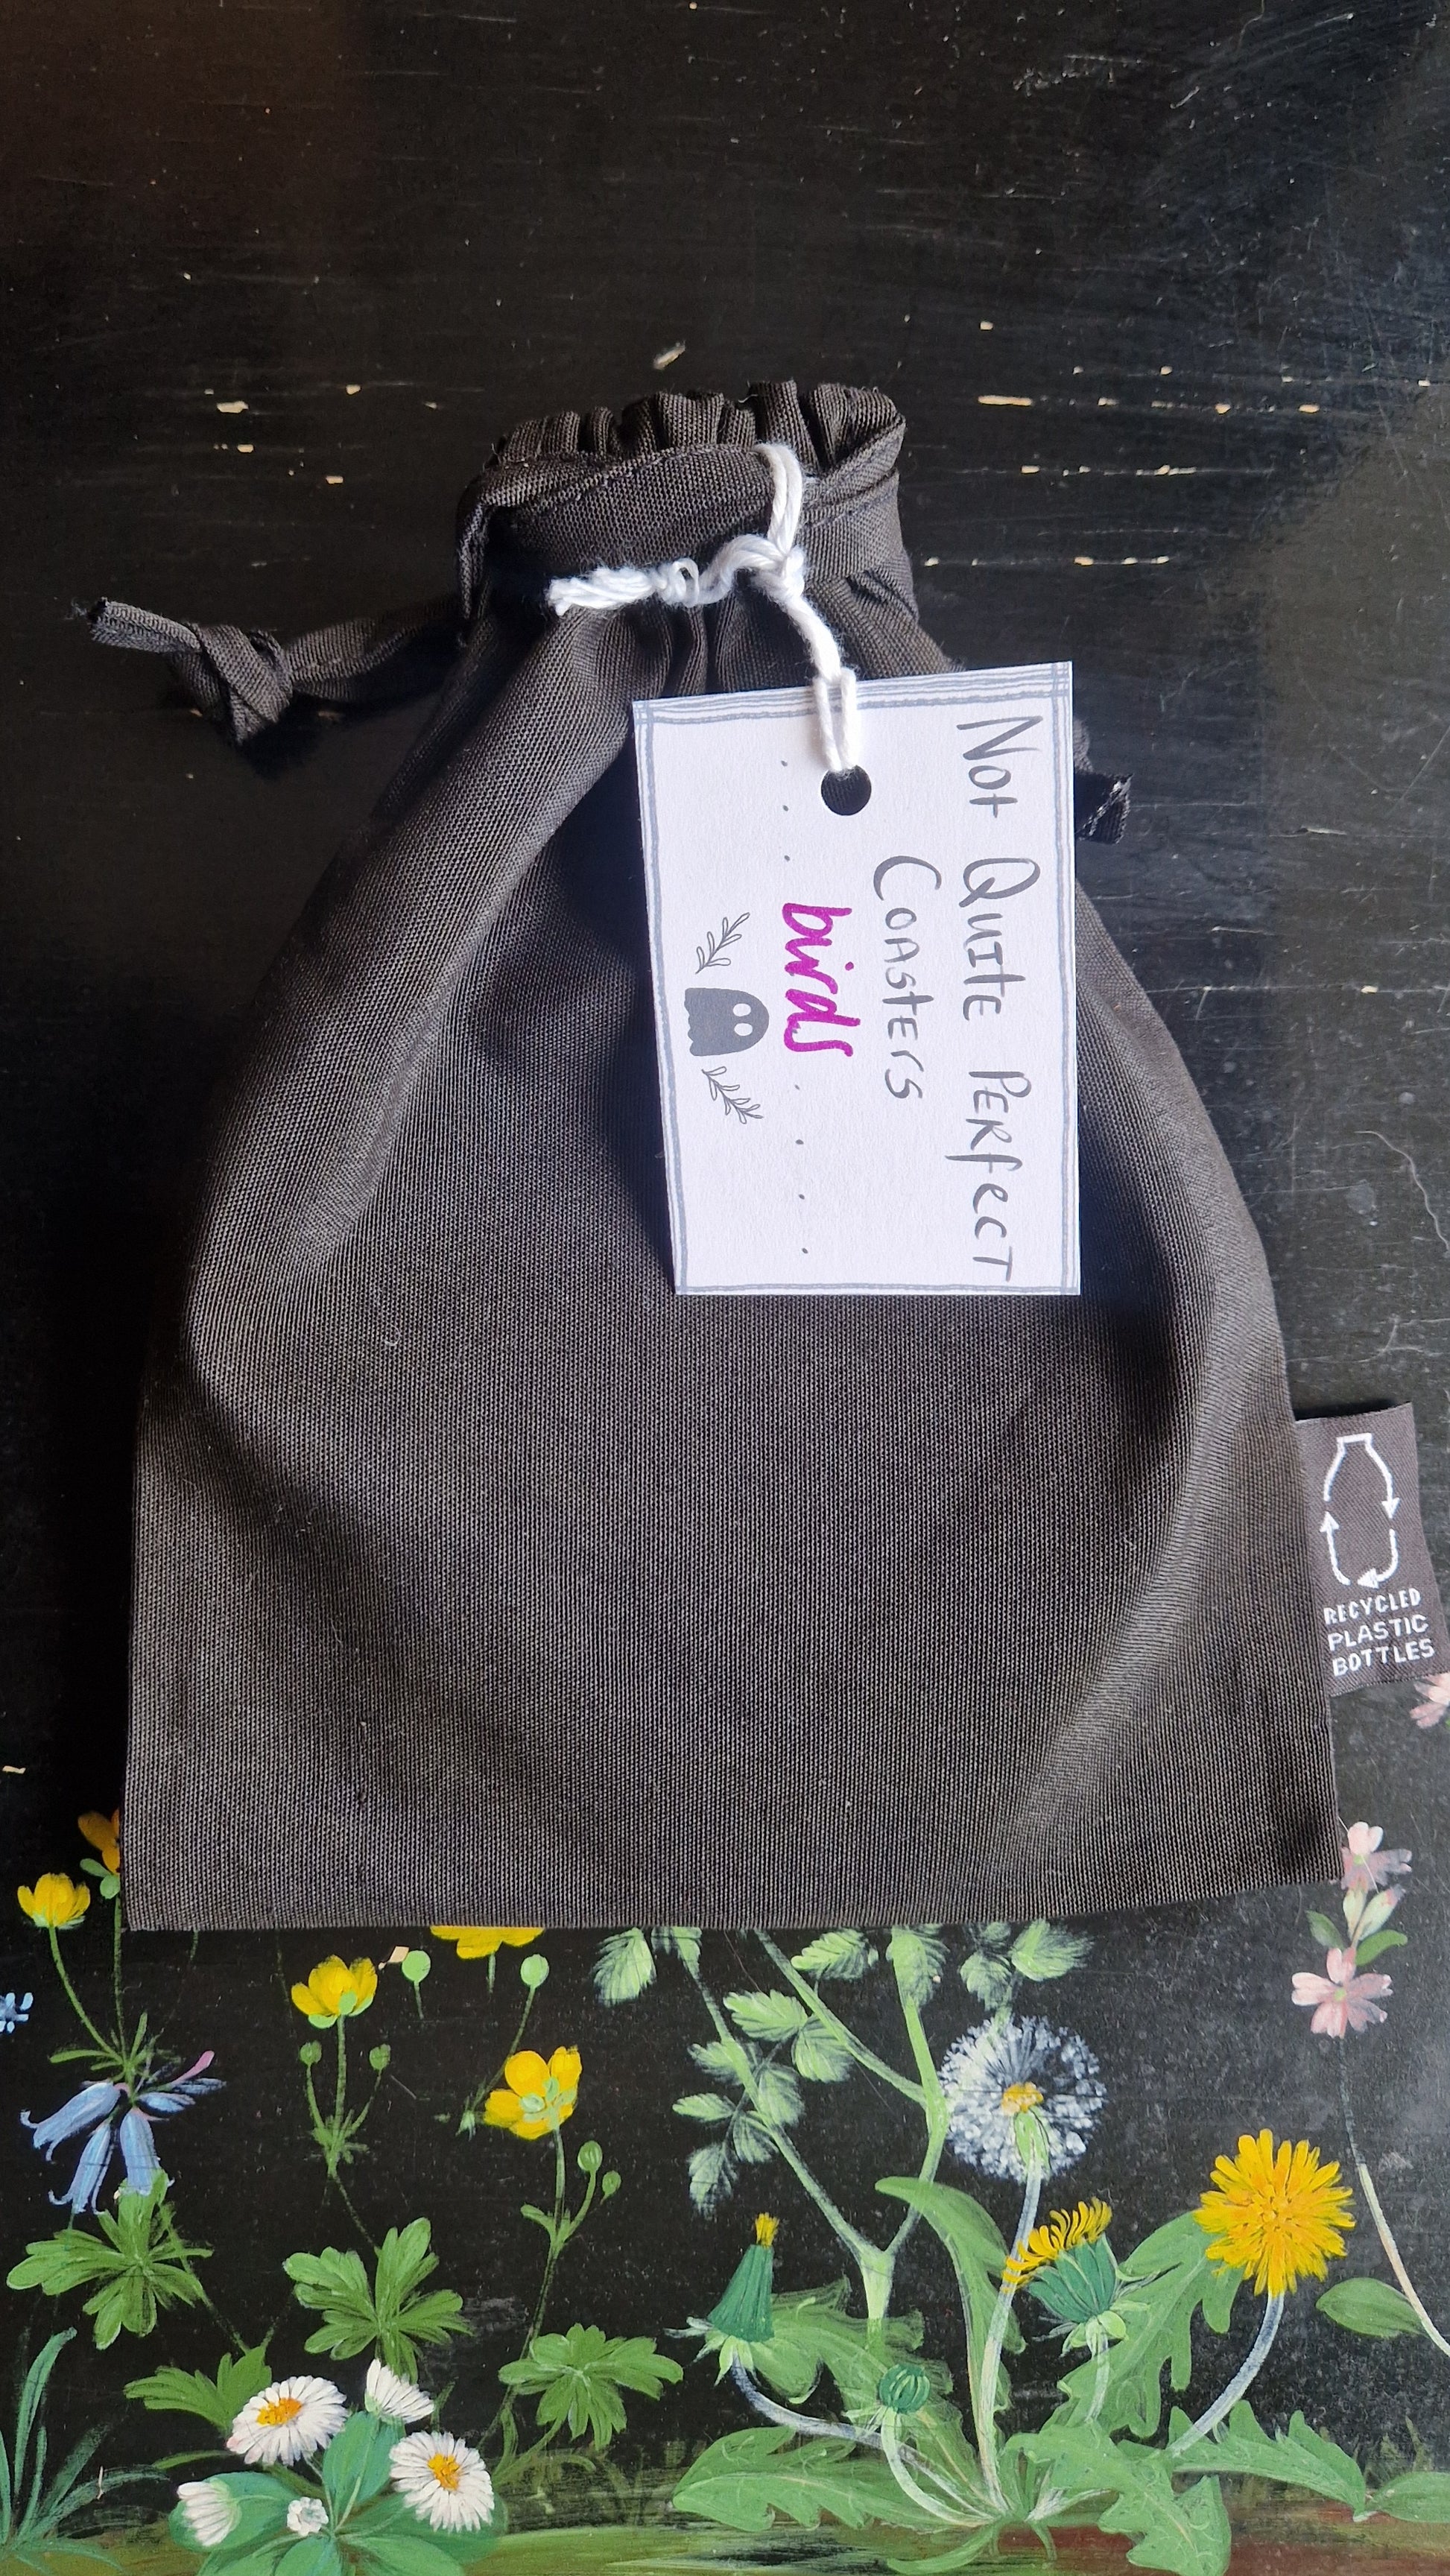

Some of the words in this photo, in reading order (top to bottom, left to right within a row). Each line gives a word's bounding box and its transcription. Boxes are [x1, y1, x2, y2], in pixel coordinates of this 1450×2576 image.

[956, 715, 1043, 819] Not
[781, 902, 861, 1057] birds
[1323, 1587, 1422, 1625] RECYCLED
[1327, 1613, 1429, 1652] PLASTIC
[1331, 1637, 1435, 1677] BOTTLES
